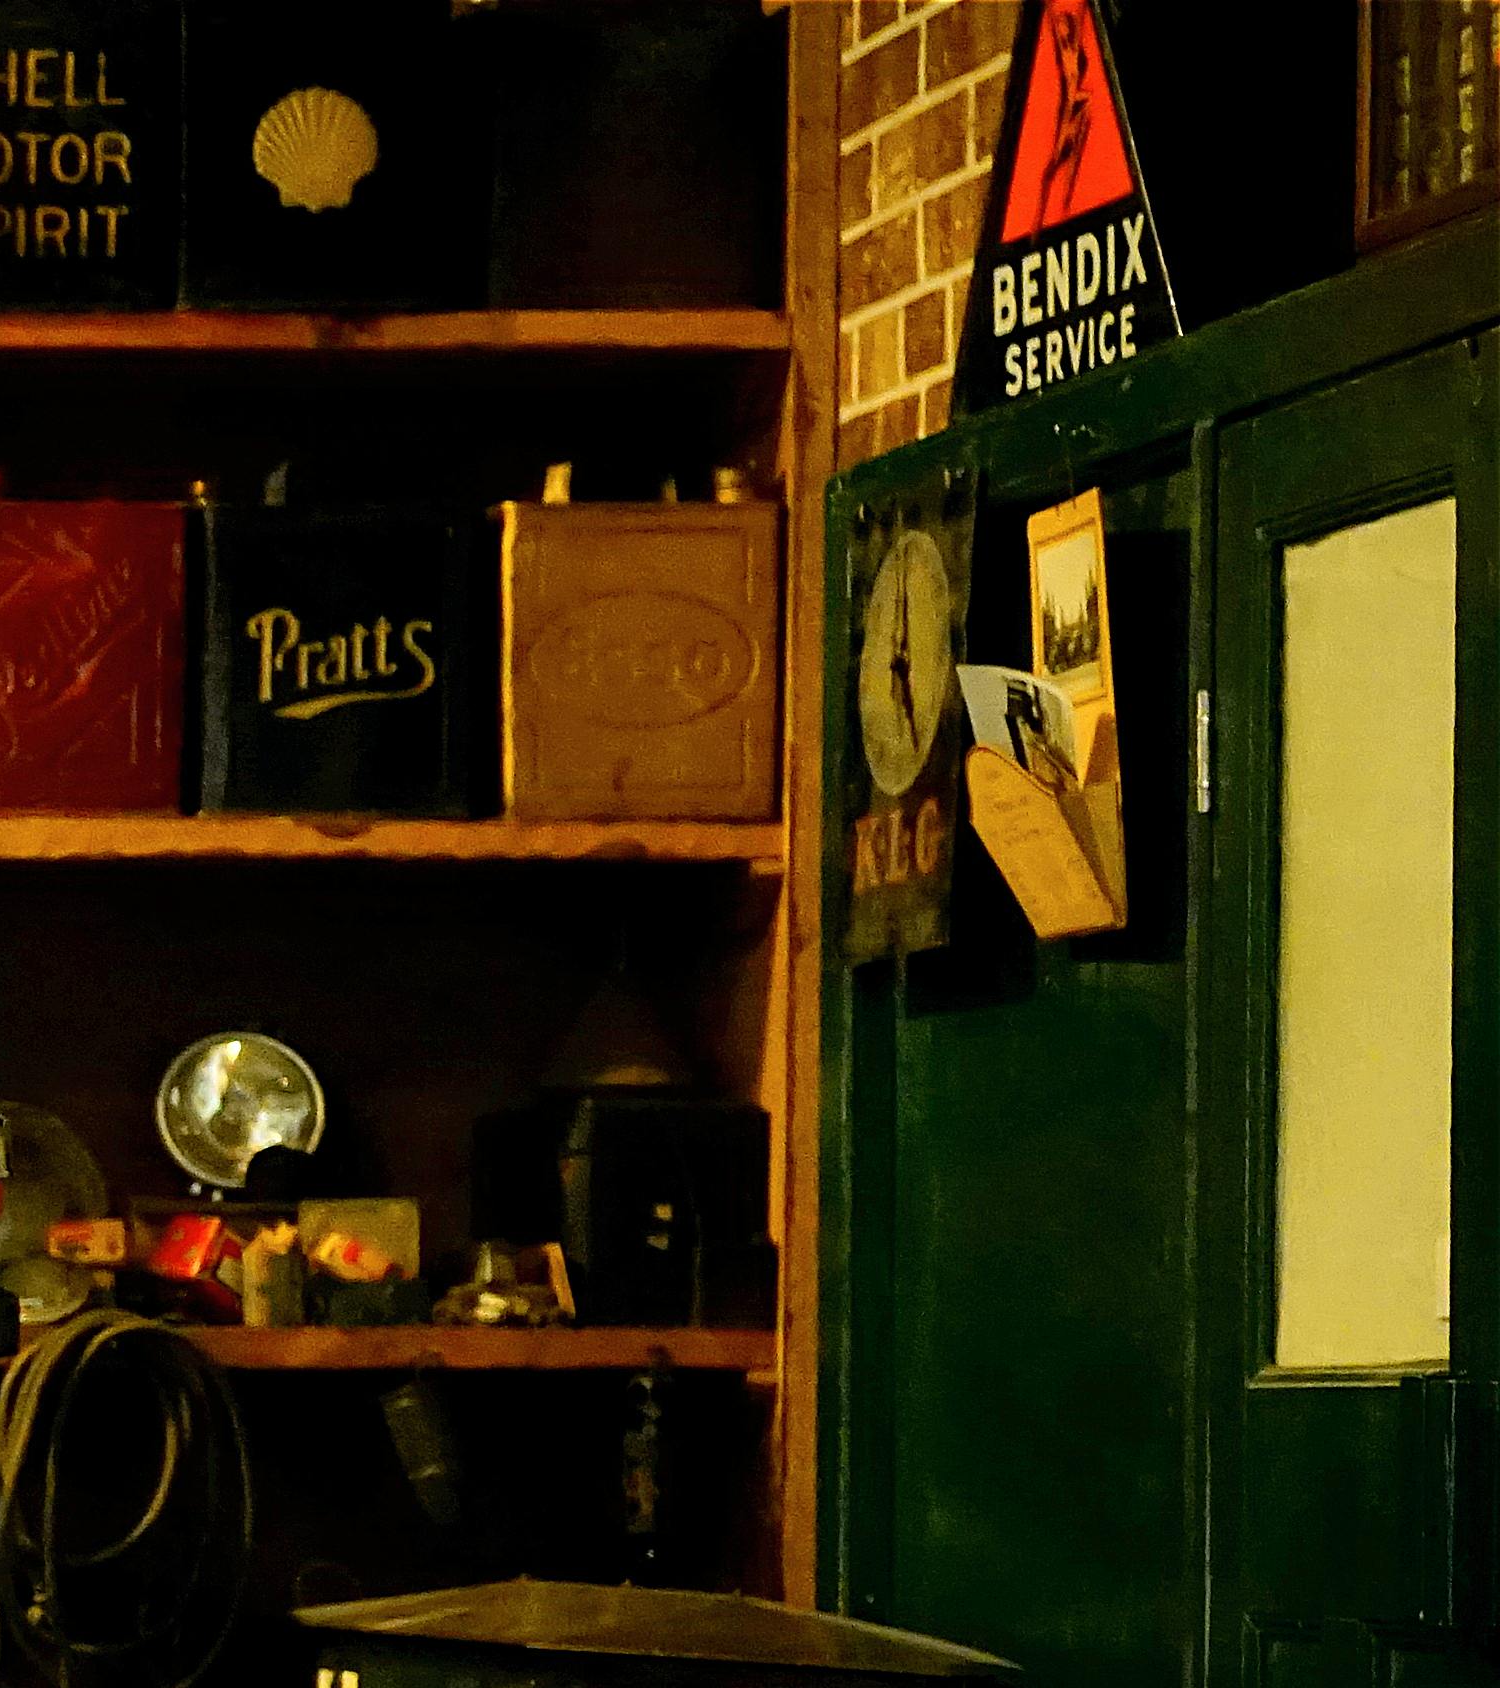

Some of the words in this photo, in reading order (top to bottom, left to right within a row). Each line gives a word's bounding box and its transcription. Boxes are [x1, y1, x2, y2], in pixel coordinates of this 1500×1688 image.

[993, 212, 1148, 336] BENDIX
[1004, 304, 1136, 398] SERVICE
[247, 606, 434, 719] Pratts
